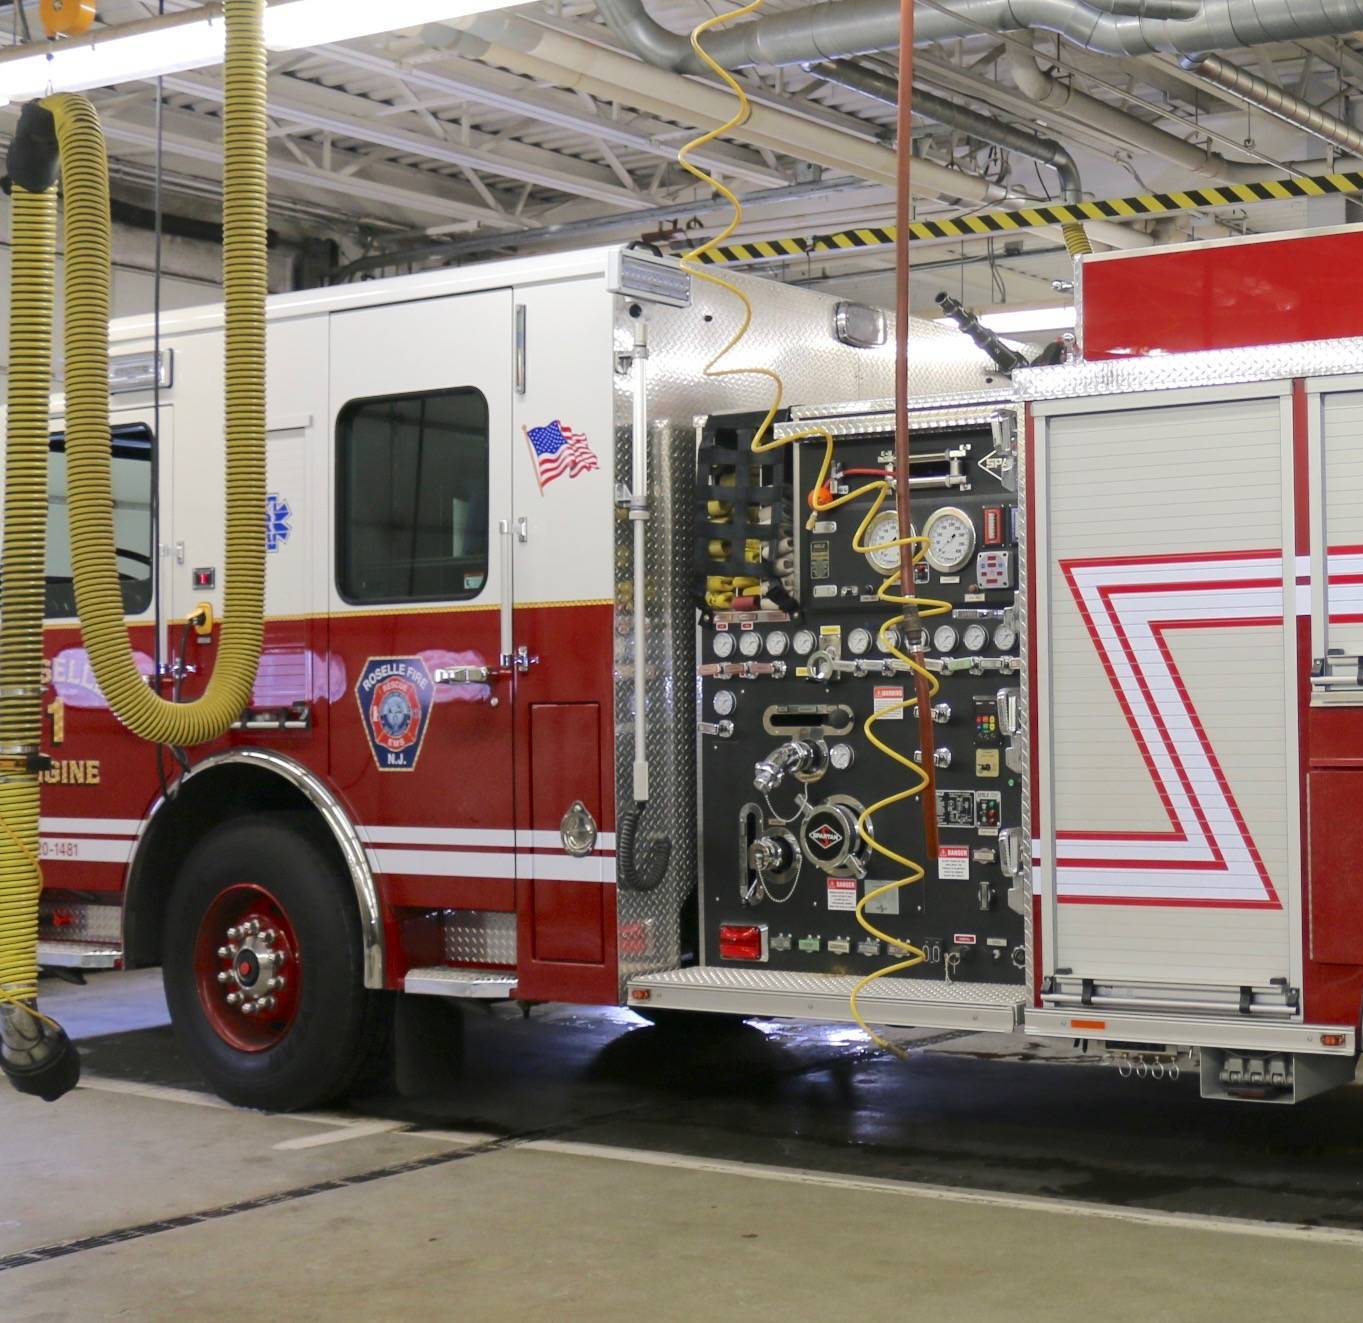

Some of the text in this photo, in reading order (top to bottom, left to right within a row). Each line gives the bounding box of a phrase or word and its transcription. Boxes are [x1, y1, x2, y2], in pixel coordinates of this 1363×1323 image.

[362, 663, 428, 692] ROSELLE FIRE
[47, 696, 65, 745] 1
[38, 760, 100, 784] GINE
[387, 753, 407, 766] N.J.
